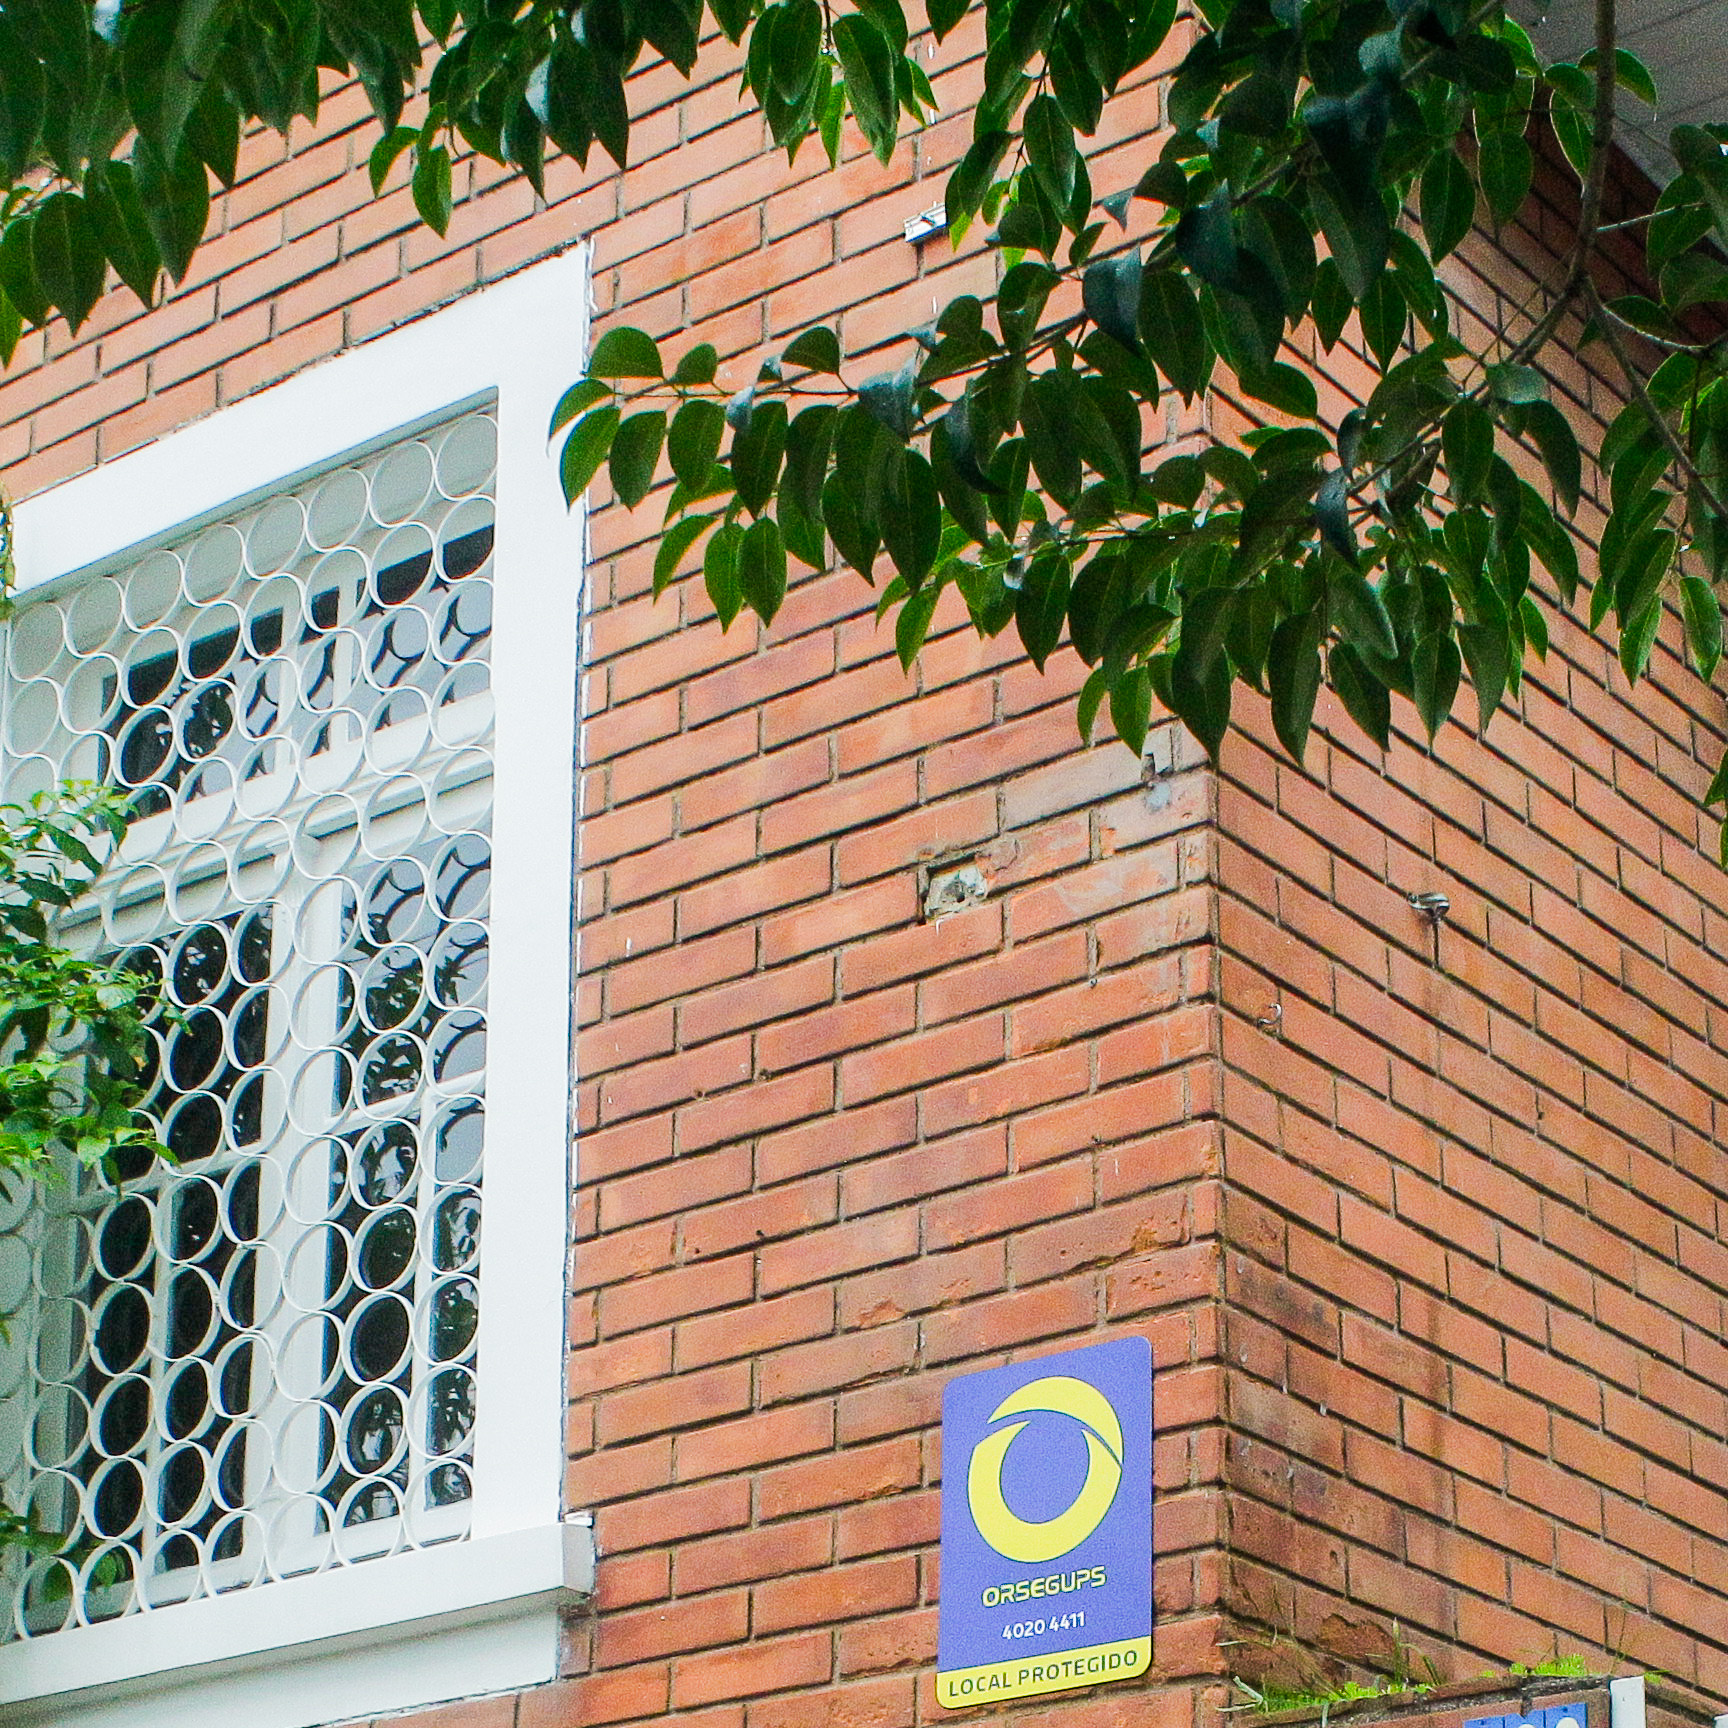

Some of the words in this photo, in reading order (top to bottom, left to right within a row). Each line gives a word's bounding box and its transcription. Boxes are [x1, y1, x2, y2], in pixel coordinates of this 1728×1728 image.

[982, 1565, 1107, 1608] ORSEGUPS
[1002, 1619, 1046, 1640] 4020
[1048, 1611, 1086, 1633] 4411
[949, 1671, 1012, 1697] LOCAL
[1018, 1650, 1138, 1685] PROTEGIDO
